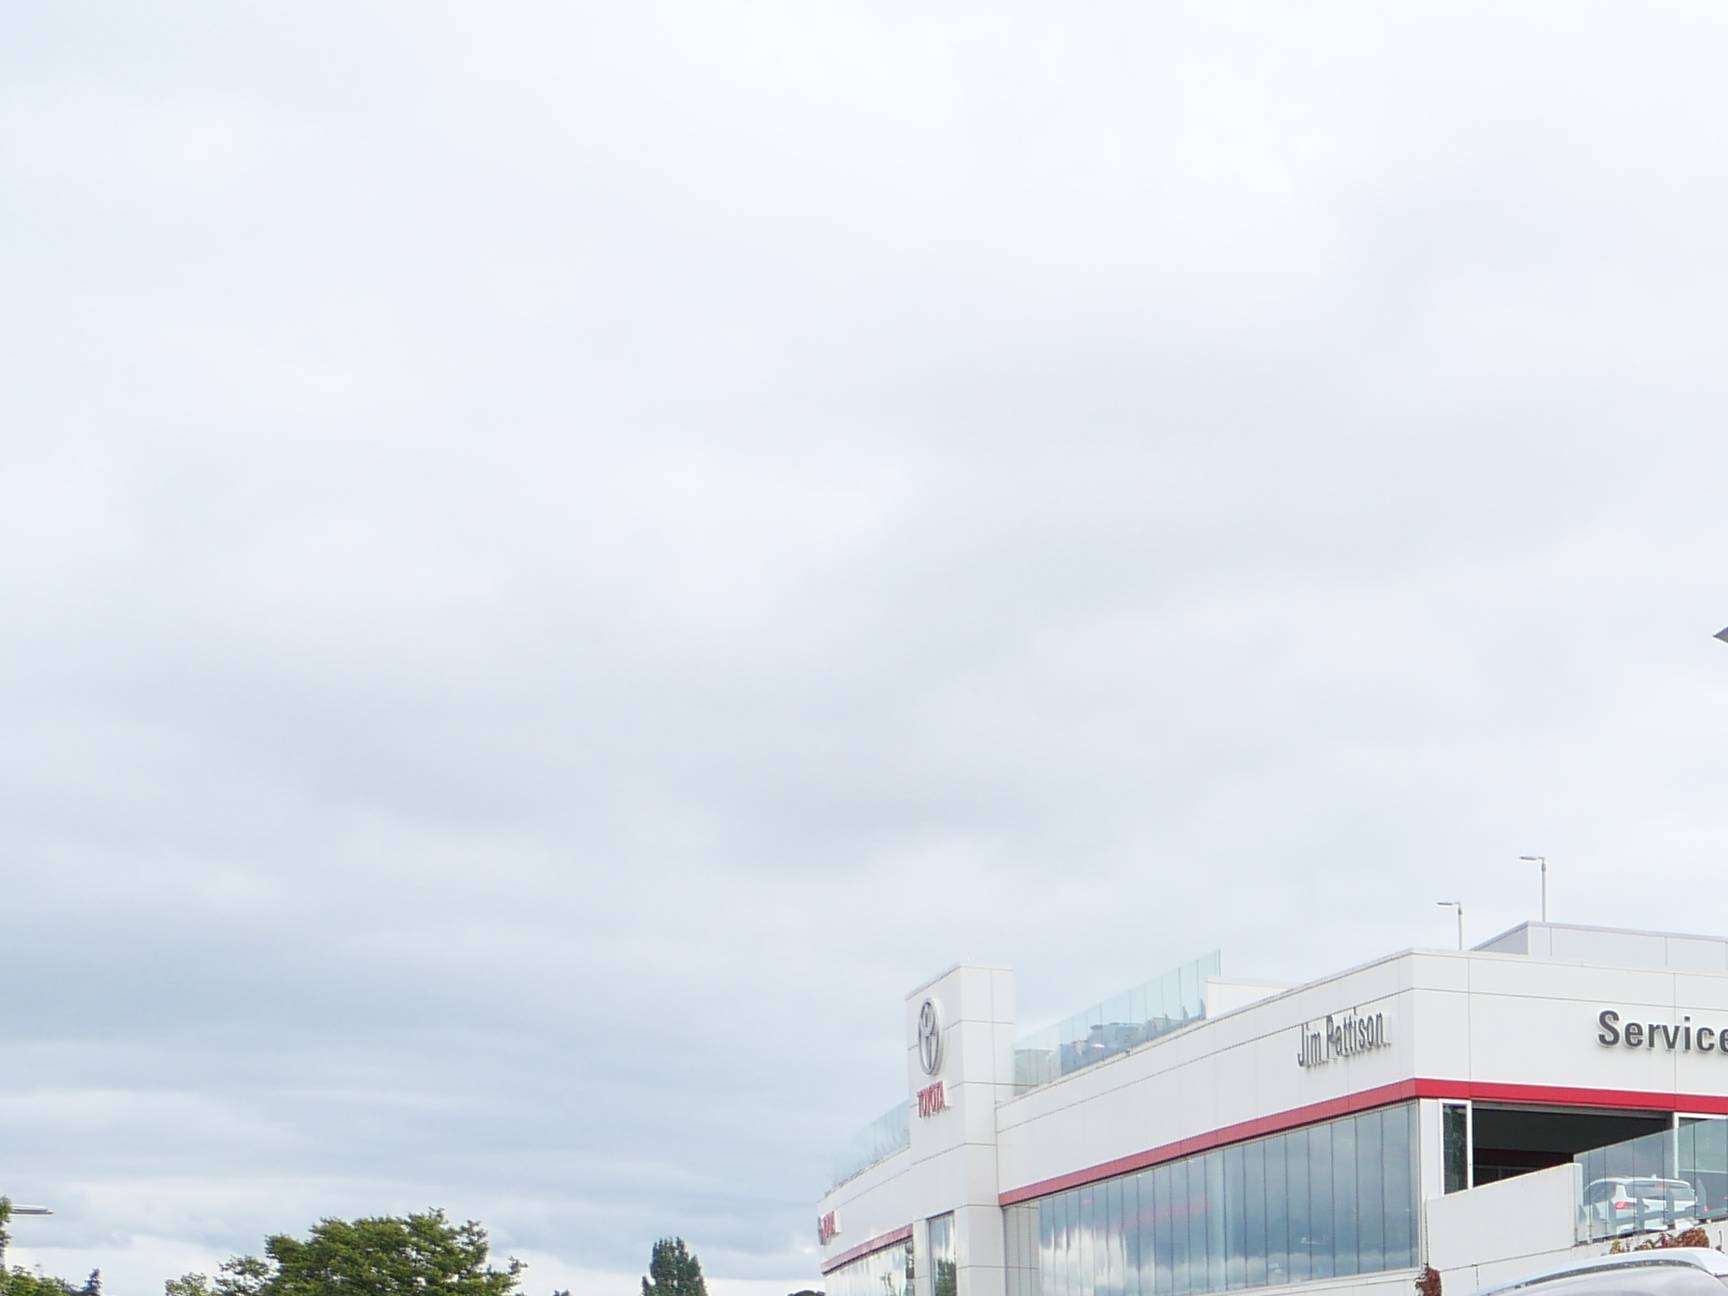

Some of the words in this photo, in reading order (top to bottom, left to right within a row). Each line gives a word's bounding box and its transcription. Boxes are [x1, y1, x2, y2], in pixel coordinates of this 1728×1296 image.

[1298, 1022, 1321, 1067] Jim
[1326, 1007, 1384, 1059] Pattison
[917, 1080, 945, 1118] TOYOTA
